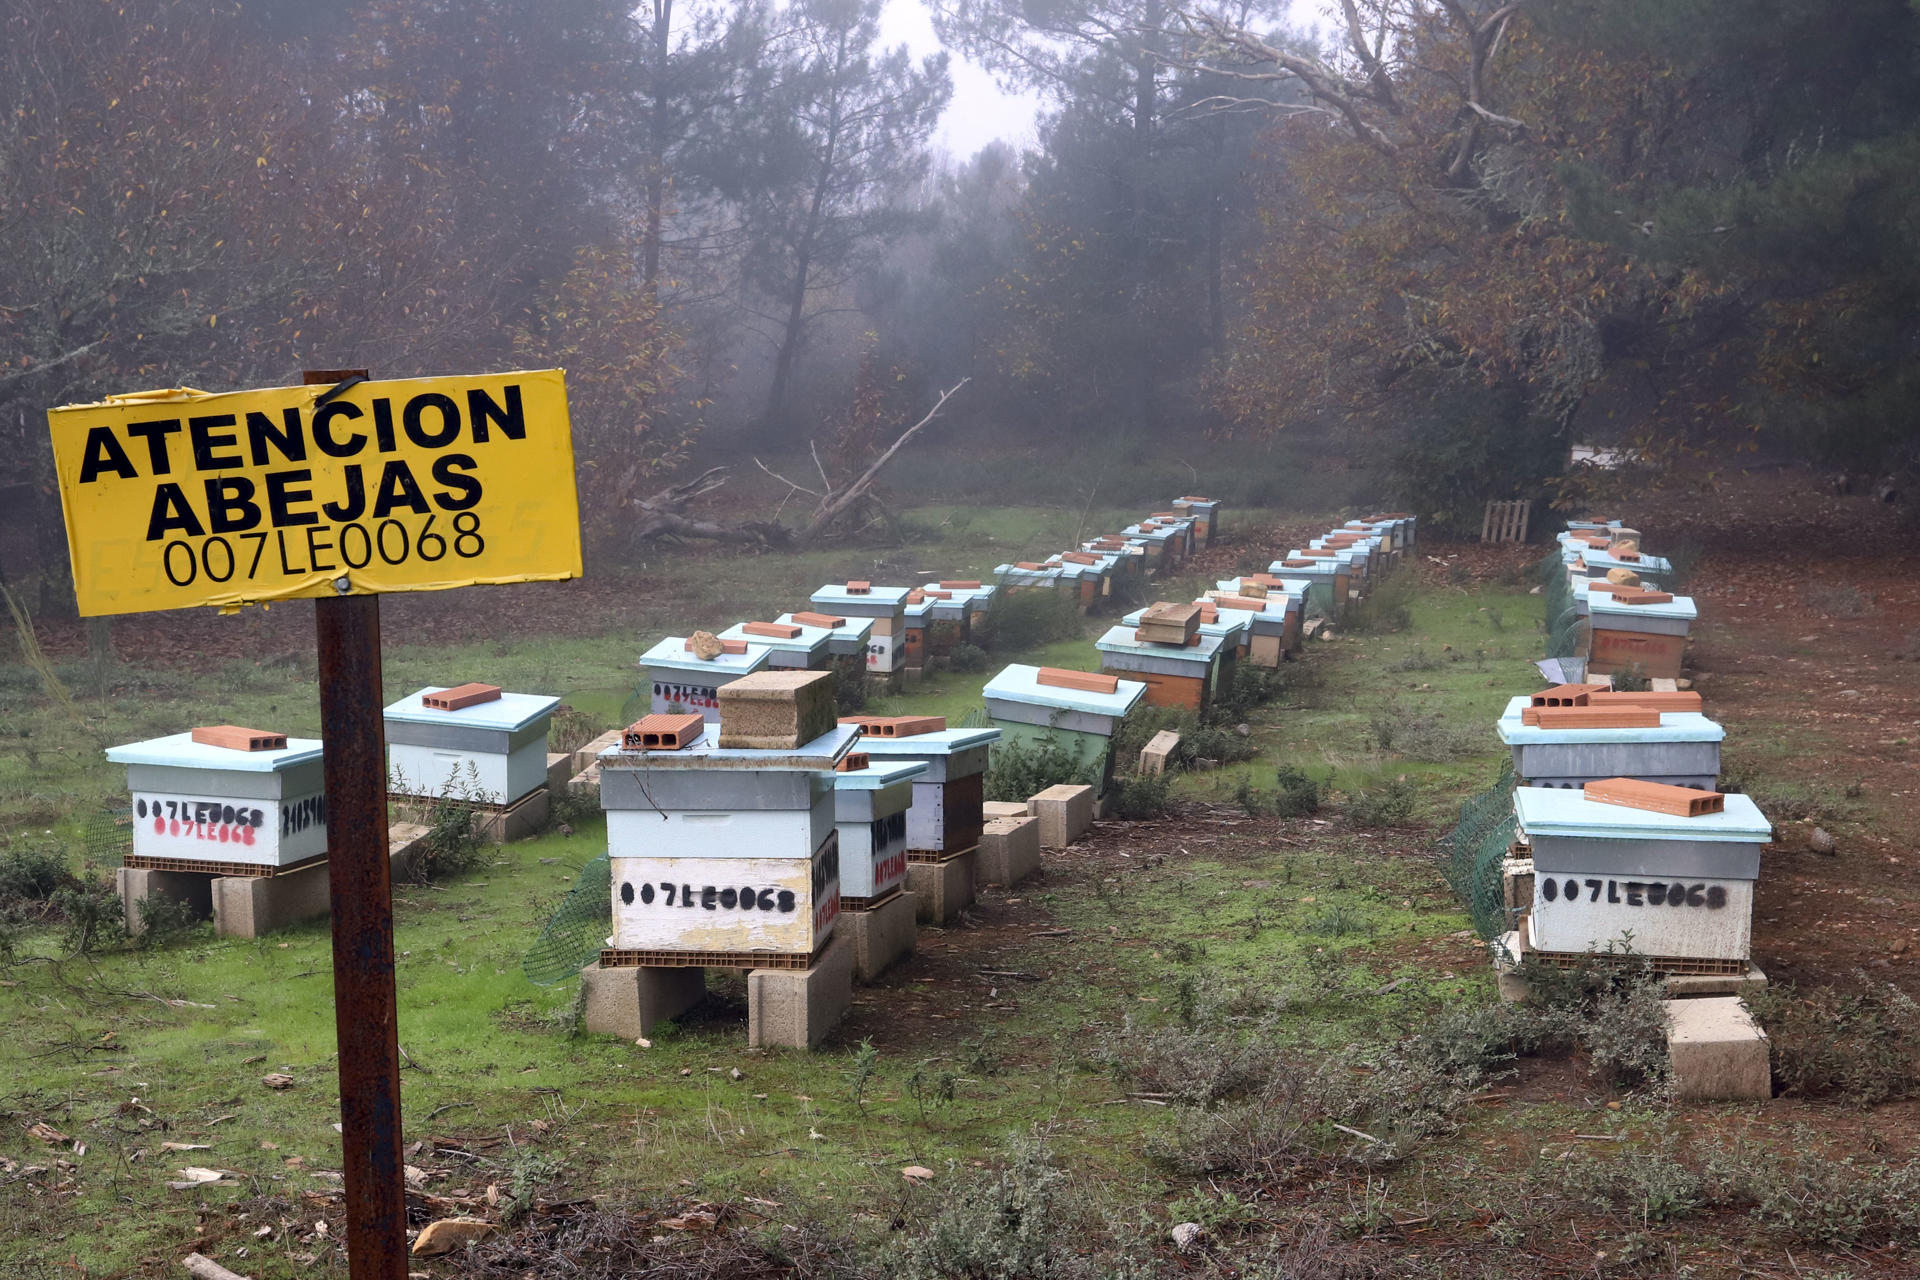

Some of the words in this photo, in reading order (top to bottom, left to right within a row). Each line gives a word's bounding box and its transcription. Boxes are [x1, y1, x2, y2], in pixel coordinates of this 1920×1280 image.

[79, 385, 527, 484] ATENCION
[146, 454, 483, 541] ABEJAS
[163, 511, 485, 587] 007LE0068
[137, 798, 264, 828] 007LE0068
[620, 881, 796, 913] 007LE0068
[1542, 877, 1728, 910] 007LE0068
